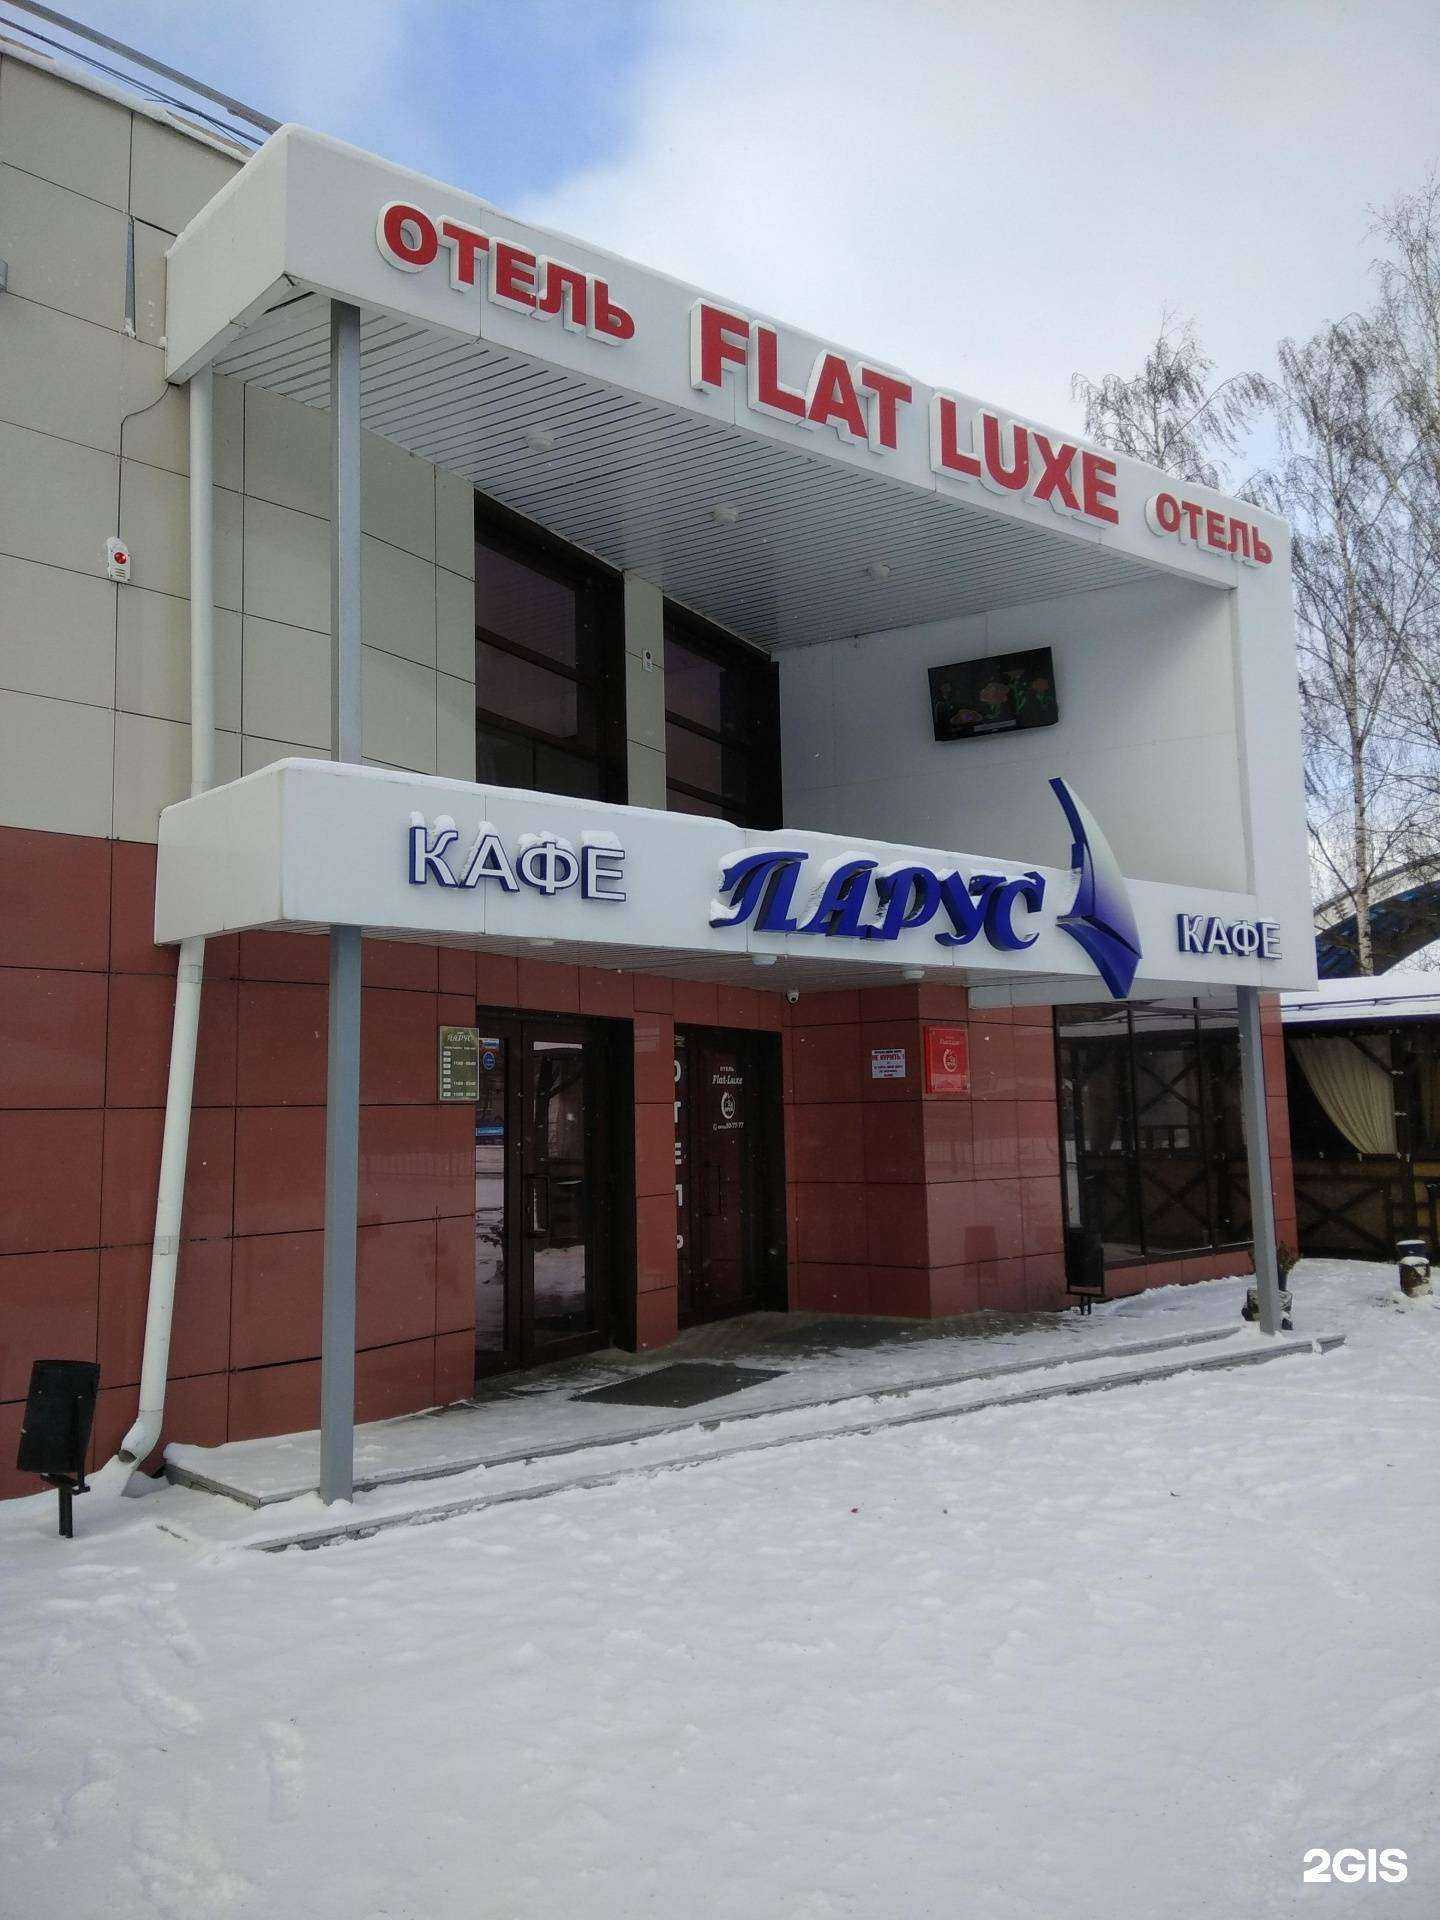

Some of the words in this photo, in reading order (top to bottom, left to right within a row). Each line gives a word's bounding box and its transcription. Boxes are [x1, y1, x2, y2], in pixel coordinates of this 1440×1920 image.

[379, 201, 636, 345] ОТЕЛЬ
[692, 300, 913, 450] FLAT
[932, 395, 1119, 526] LUXE
[1147, 491, 1274, 566] ОТЕЛЬ
[409, 824, 627, 902] КАФЕ
[709, 848, 1047, 951] ПАРУС
[1177, 912, 1282, 960] КАФЕ
